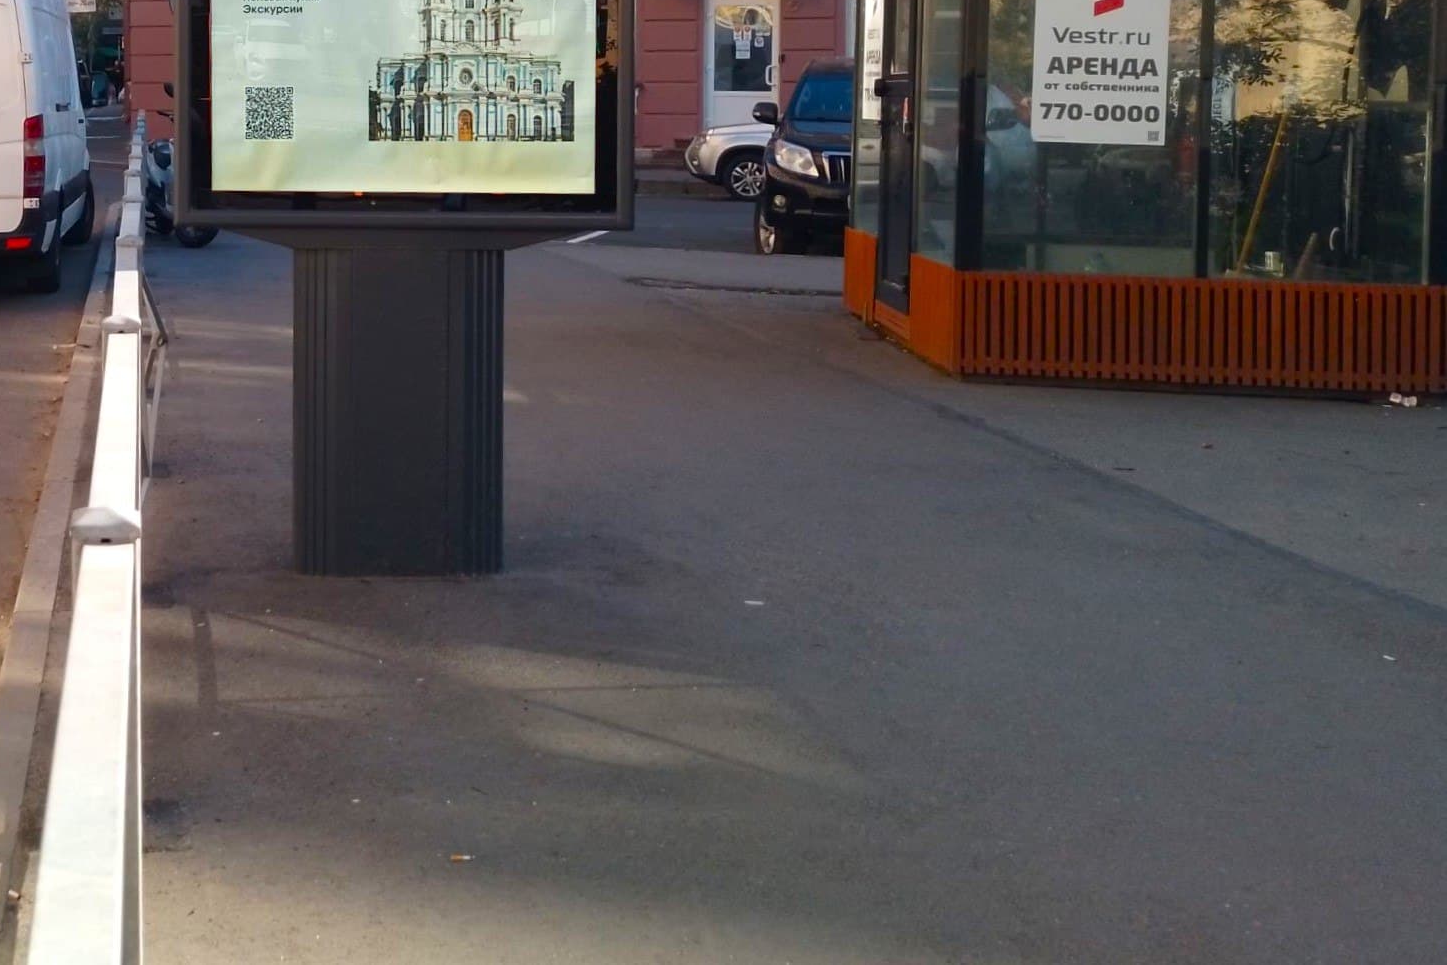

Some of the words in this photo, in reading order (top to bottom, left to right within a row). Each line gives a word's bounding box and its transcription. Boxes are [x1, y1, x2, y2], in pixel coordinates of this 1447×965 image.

[242, 4, 303, 15] Экскурсии
[1053, 27, 1151, 45] Vestr.ru
[1047, 56, 1159, 79] АРЕНДА
[1044, 81, 1058, 91] от
[1065, 80, 1160, 93] собственника
[1039, 103, 1160, 123] 770-0000
